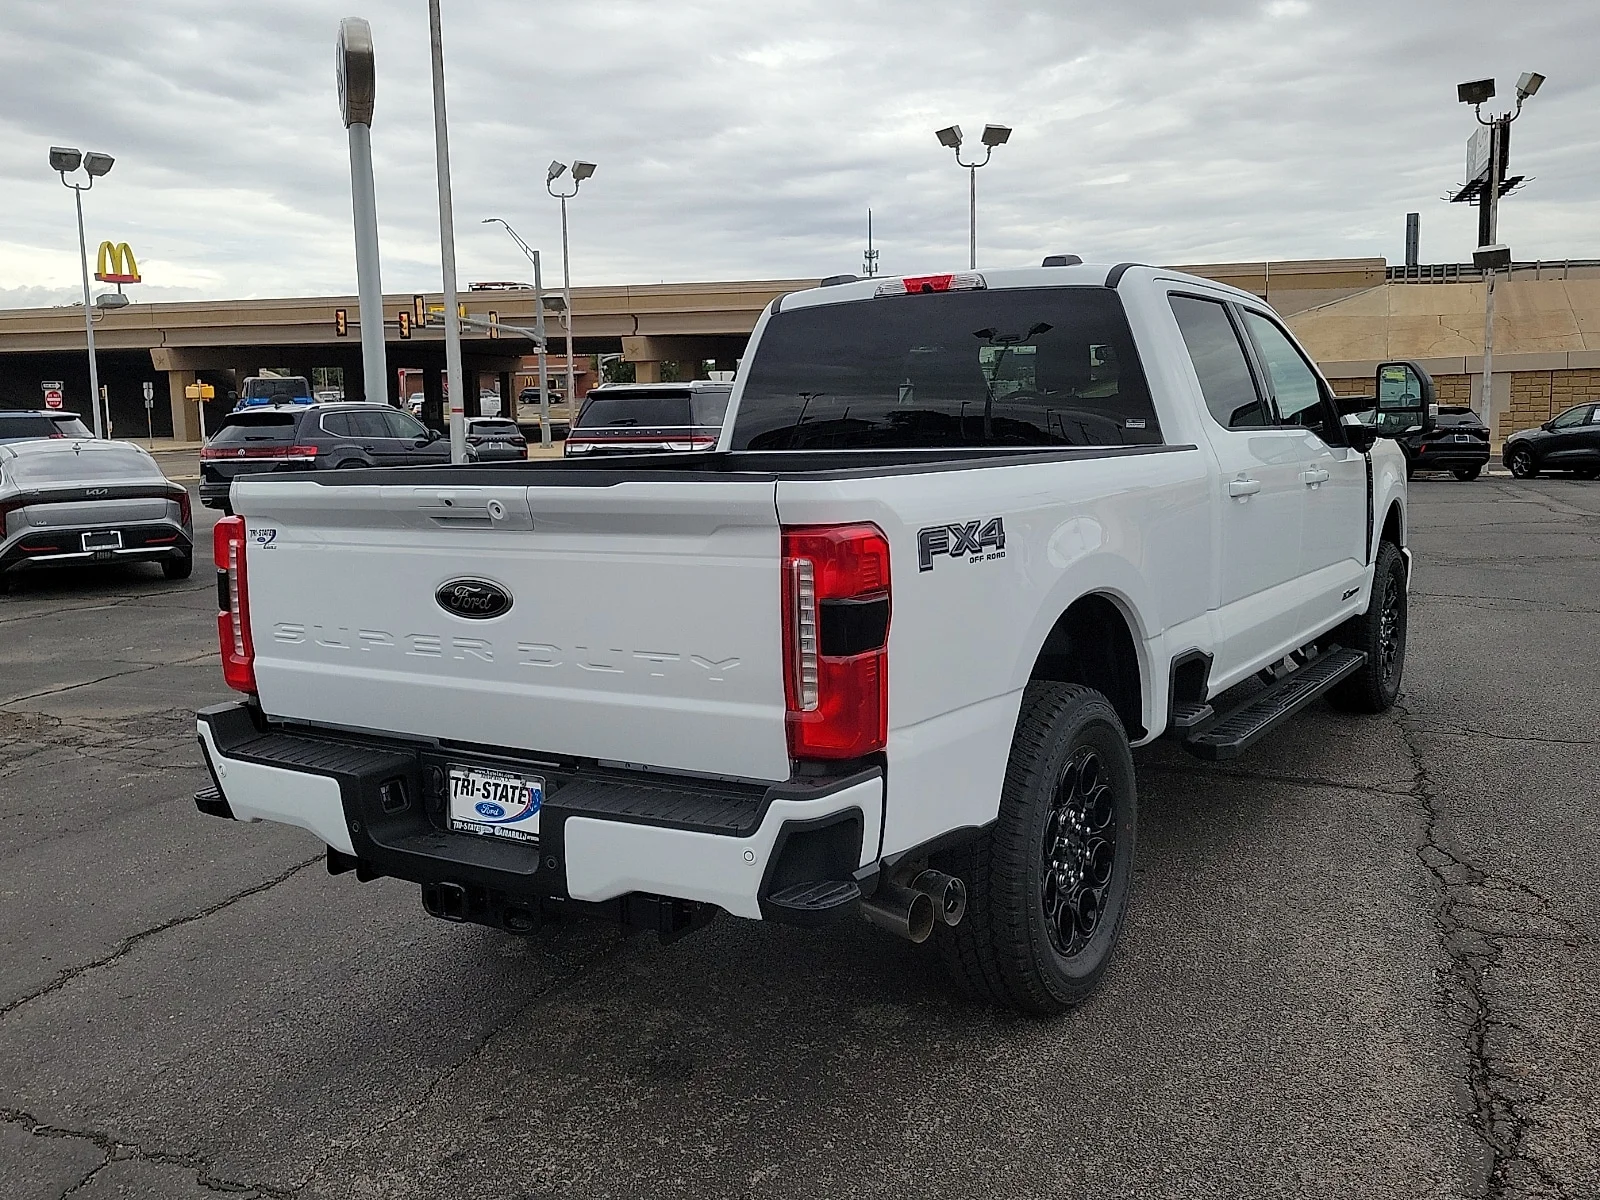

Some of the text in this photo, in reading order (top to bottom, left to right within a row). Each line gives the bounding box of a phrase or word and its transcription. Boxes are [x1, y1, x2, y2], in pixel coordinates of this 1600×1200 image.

[917, 516, 1006, 573] FX4
[969, 551, 1006, 564] OFF ROAD
[450, 585, 492, 610] Ford
[273, 621, 741, 681] SUPER DUTY
[450, 776, 530, 806] TRI-STATE
[480, 803, 500, 816] Ford
